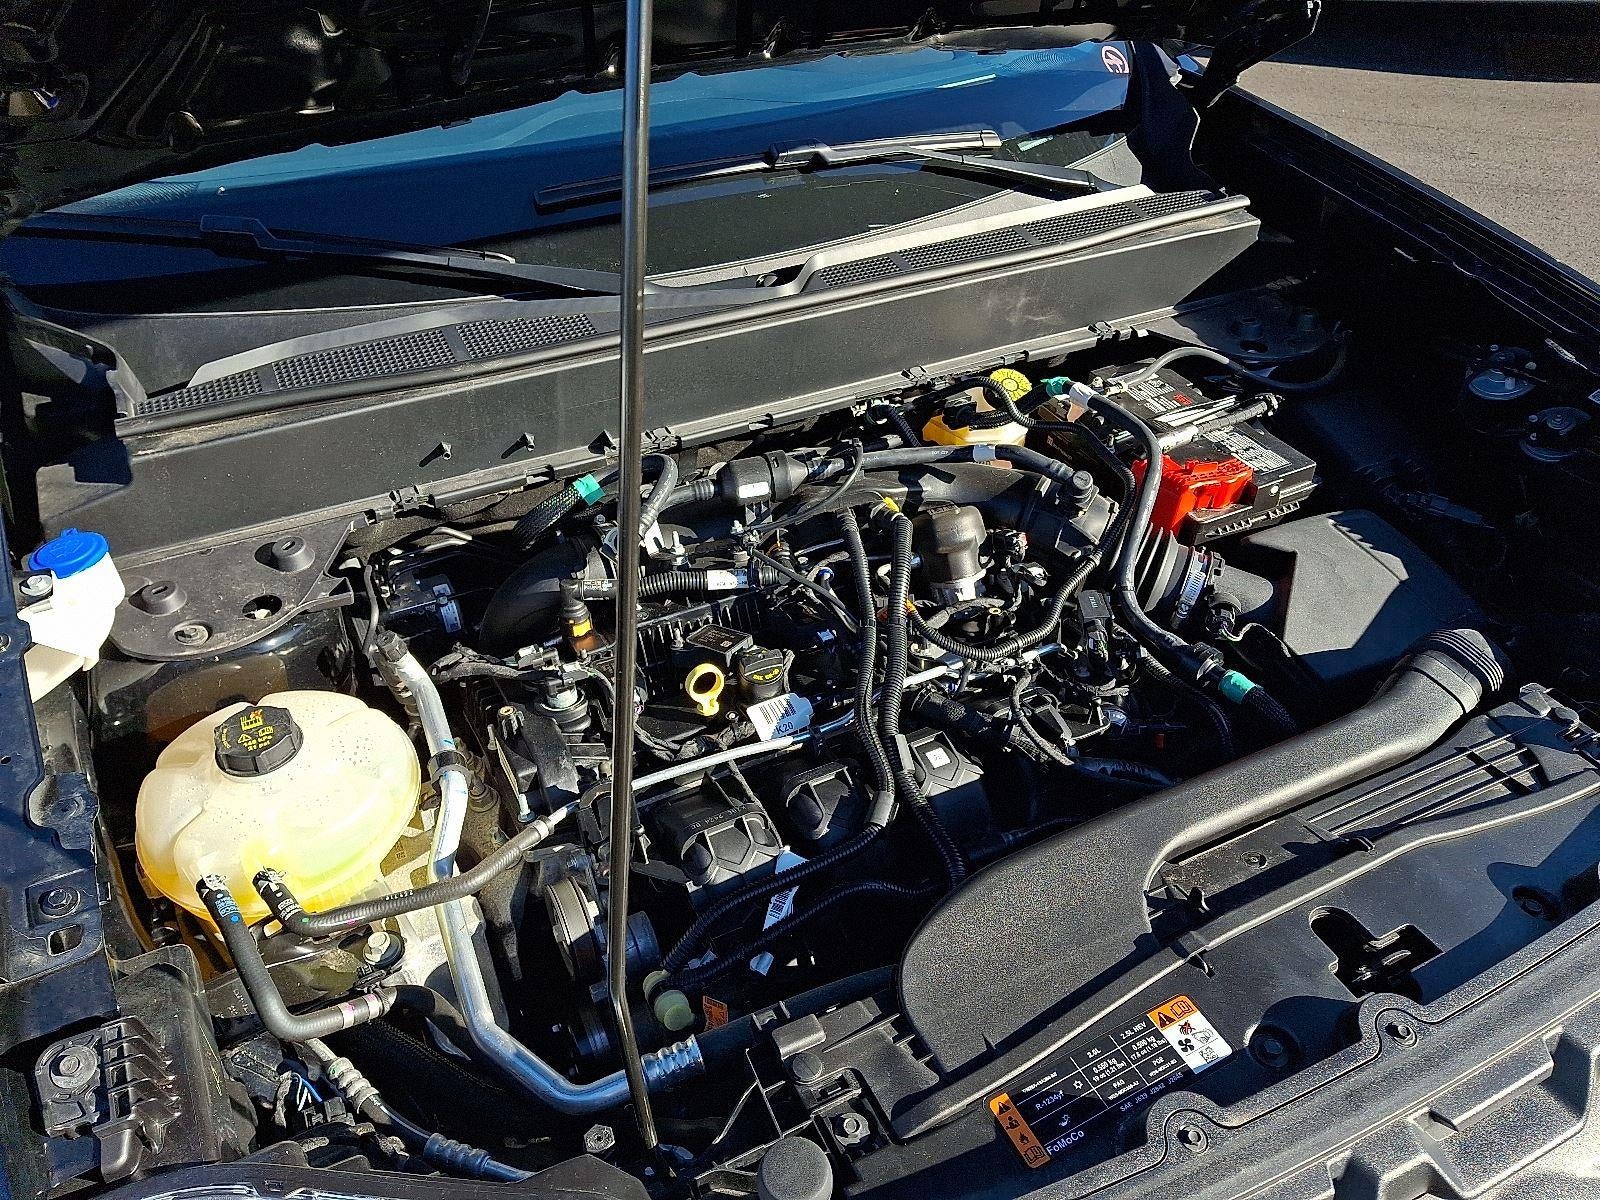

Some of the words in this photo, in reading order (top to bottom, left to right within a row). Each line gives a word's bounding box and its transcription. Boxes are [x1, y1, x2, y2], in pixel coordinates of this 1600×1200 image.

[775, 721, 794, 735] K20
[1120, 1029, 1135, 1040] 2.5L
[1133, 1021, 1147, 1033] HEV
[1145, 1035, 1156, 1044] kg
[1086, 1047, 1102, 1058] 2.0L
[1107, 1057, 1118, 1066] kg
[1035, 1089, 1065, 1111] R-1234yf
[1120, 1101, 1134, 1112] SAE
[1046, 1130, 1085, 1155] FoMoCo
